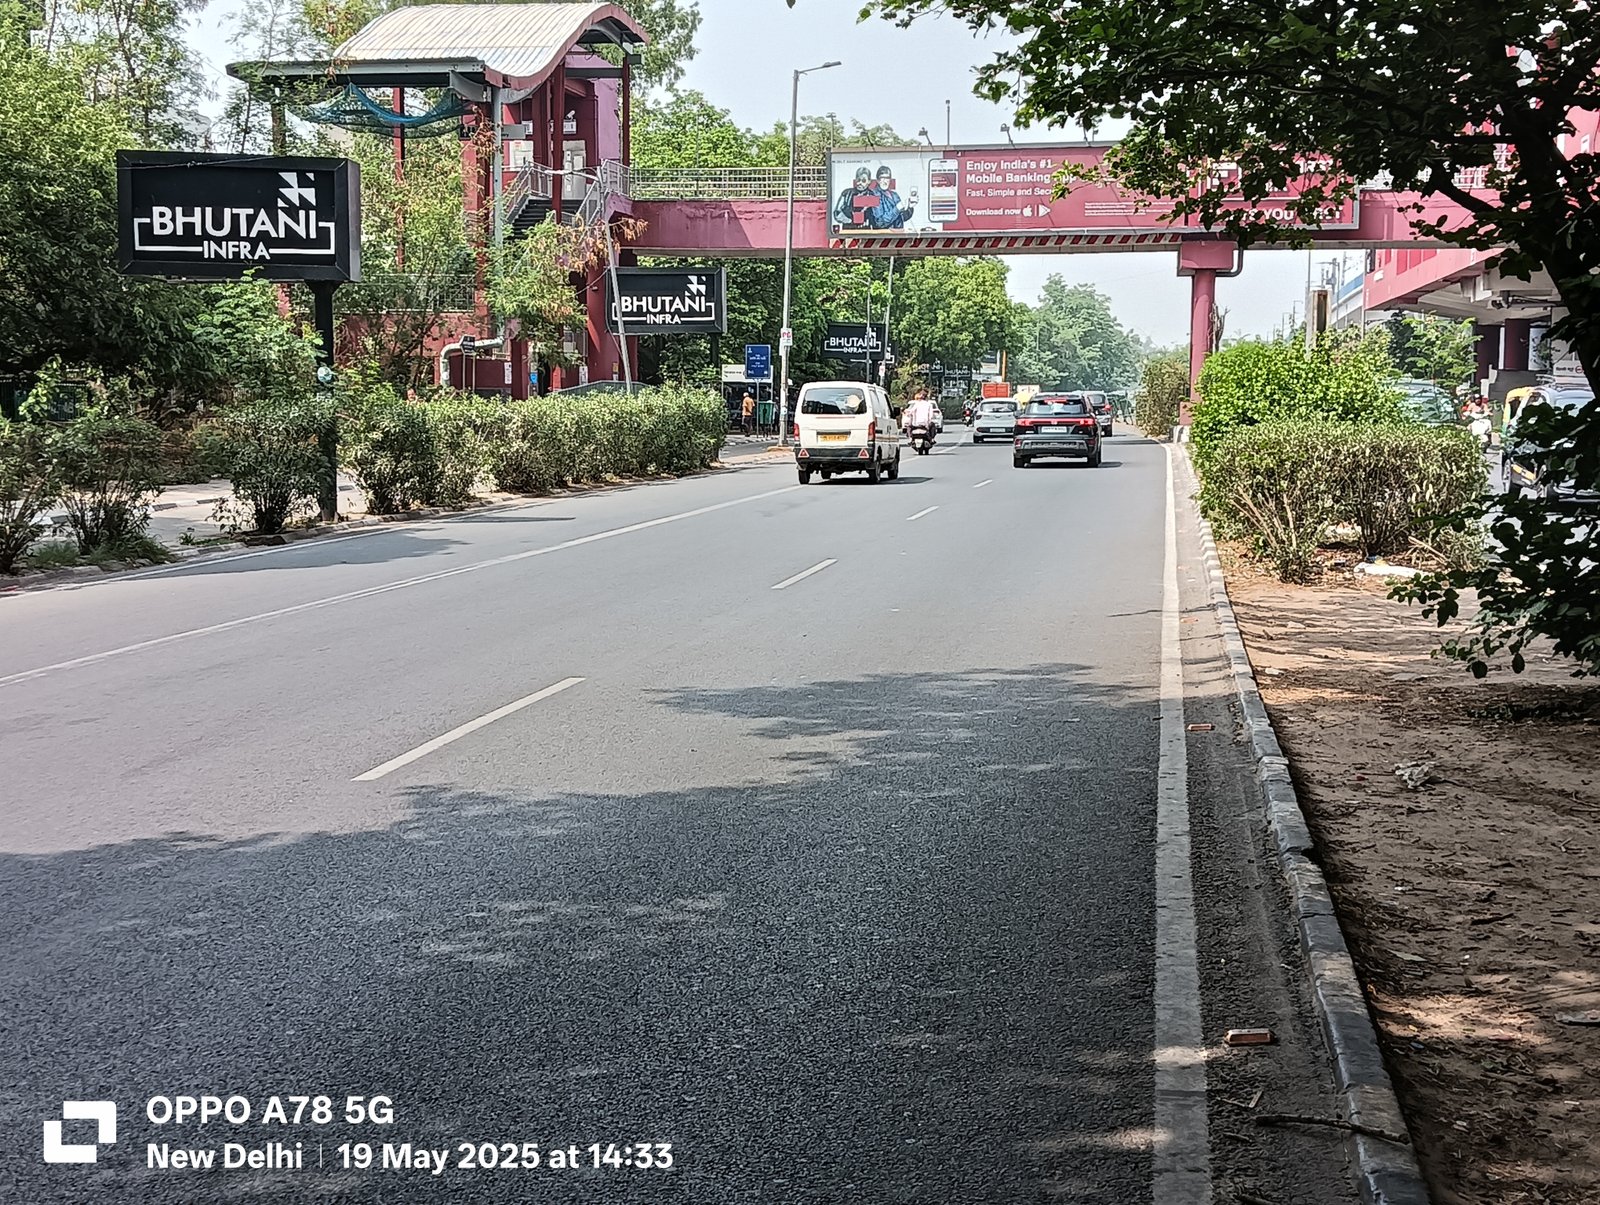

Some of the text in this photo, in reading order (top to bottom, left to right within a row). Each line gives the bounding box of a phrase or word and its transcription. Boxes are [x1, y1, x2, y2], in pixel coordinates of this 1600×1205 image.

[966, 159, 1053, 172] Enjoy India's #1
[966, 173, 1003, 183] Mobile
[1005, 172, 1051, 184] Banking
[966, 189, 986, 197] Fast,
[987, 188, 1015, 198] Simple
[1016, 188, 1032, 196] and
[966, 208, 1022, 216] Download now
[152, 205, 317, 239] BHUTANI
[203, 240, 271, 260] INFRA
[621, 296, 706, 313] BHUTANI
[646, 313, 682, 324] INFRA
[829, 337, 877, 348] BHUTANI
